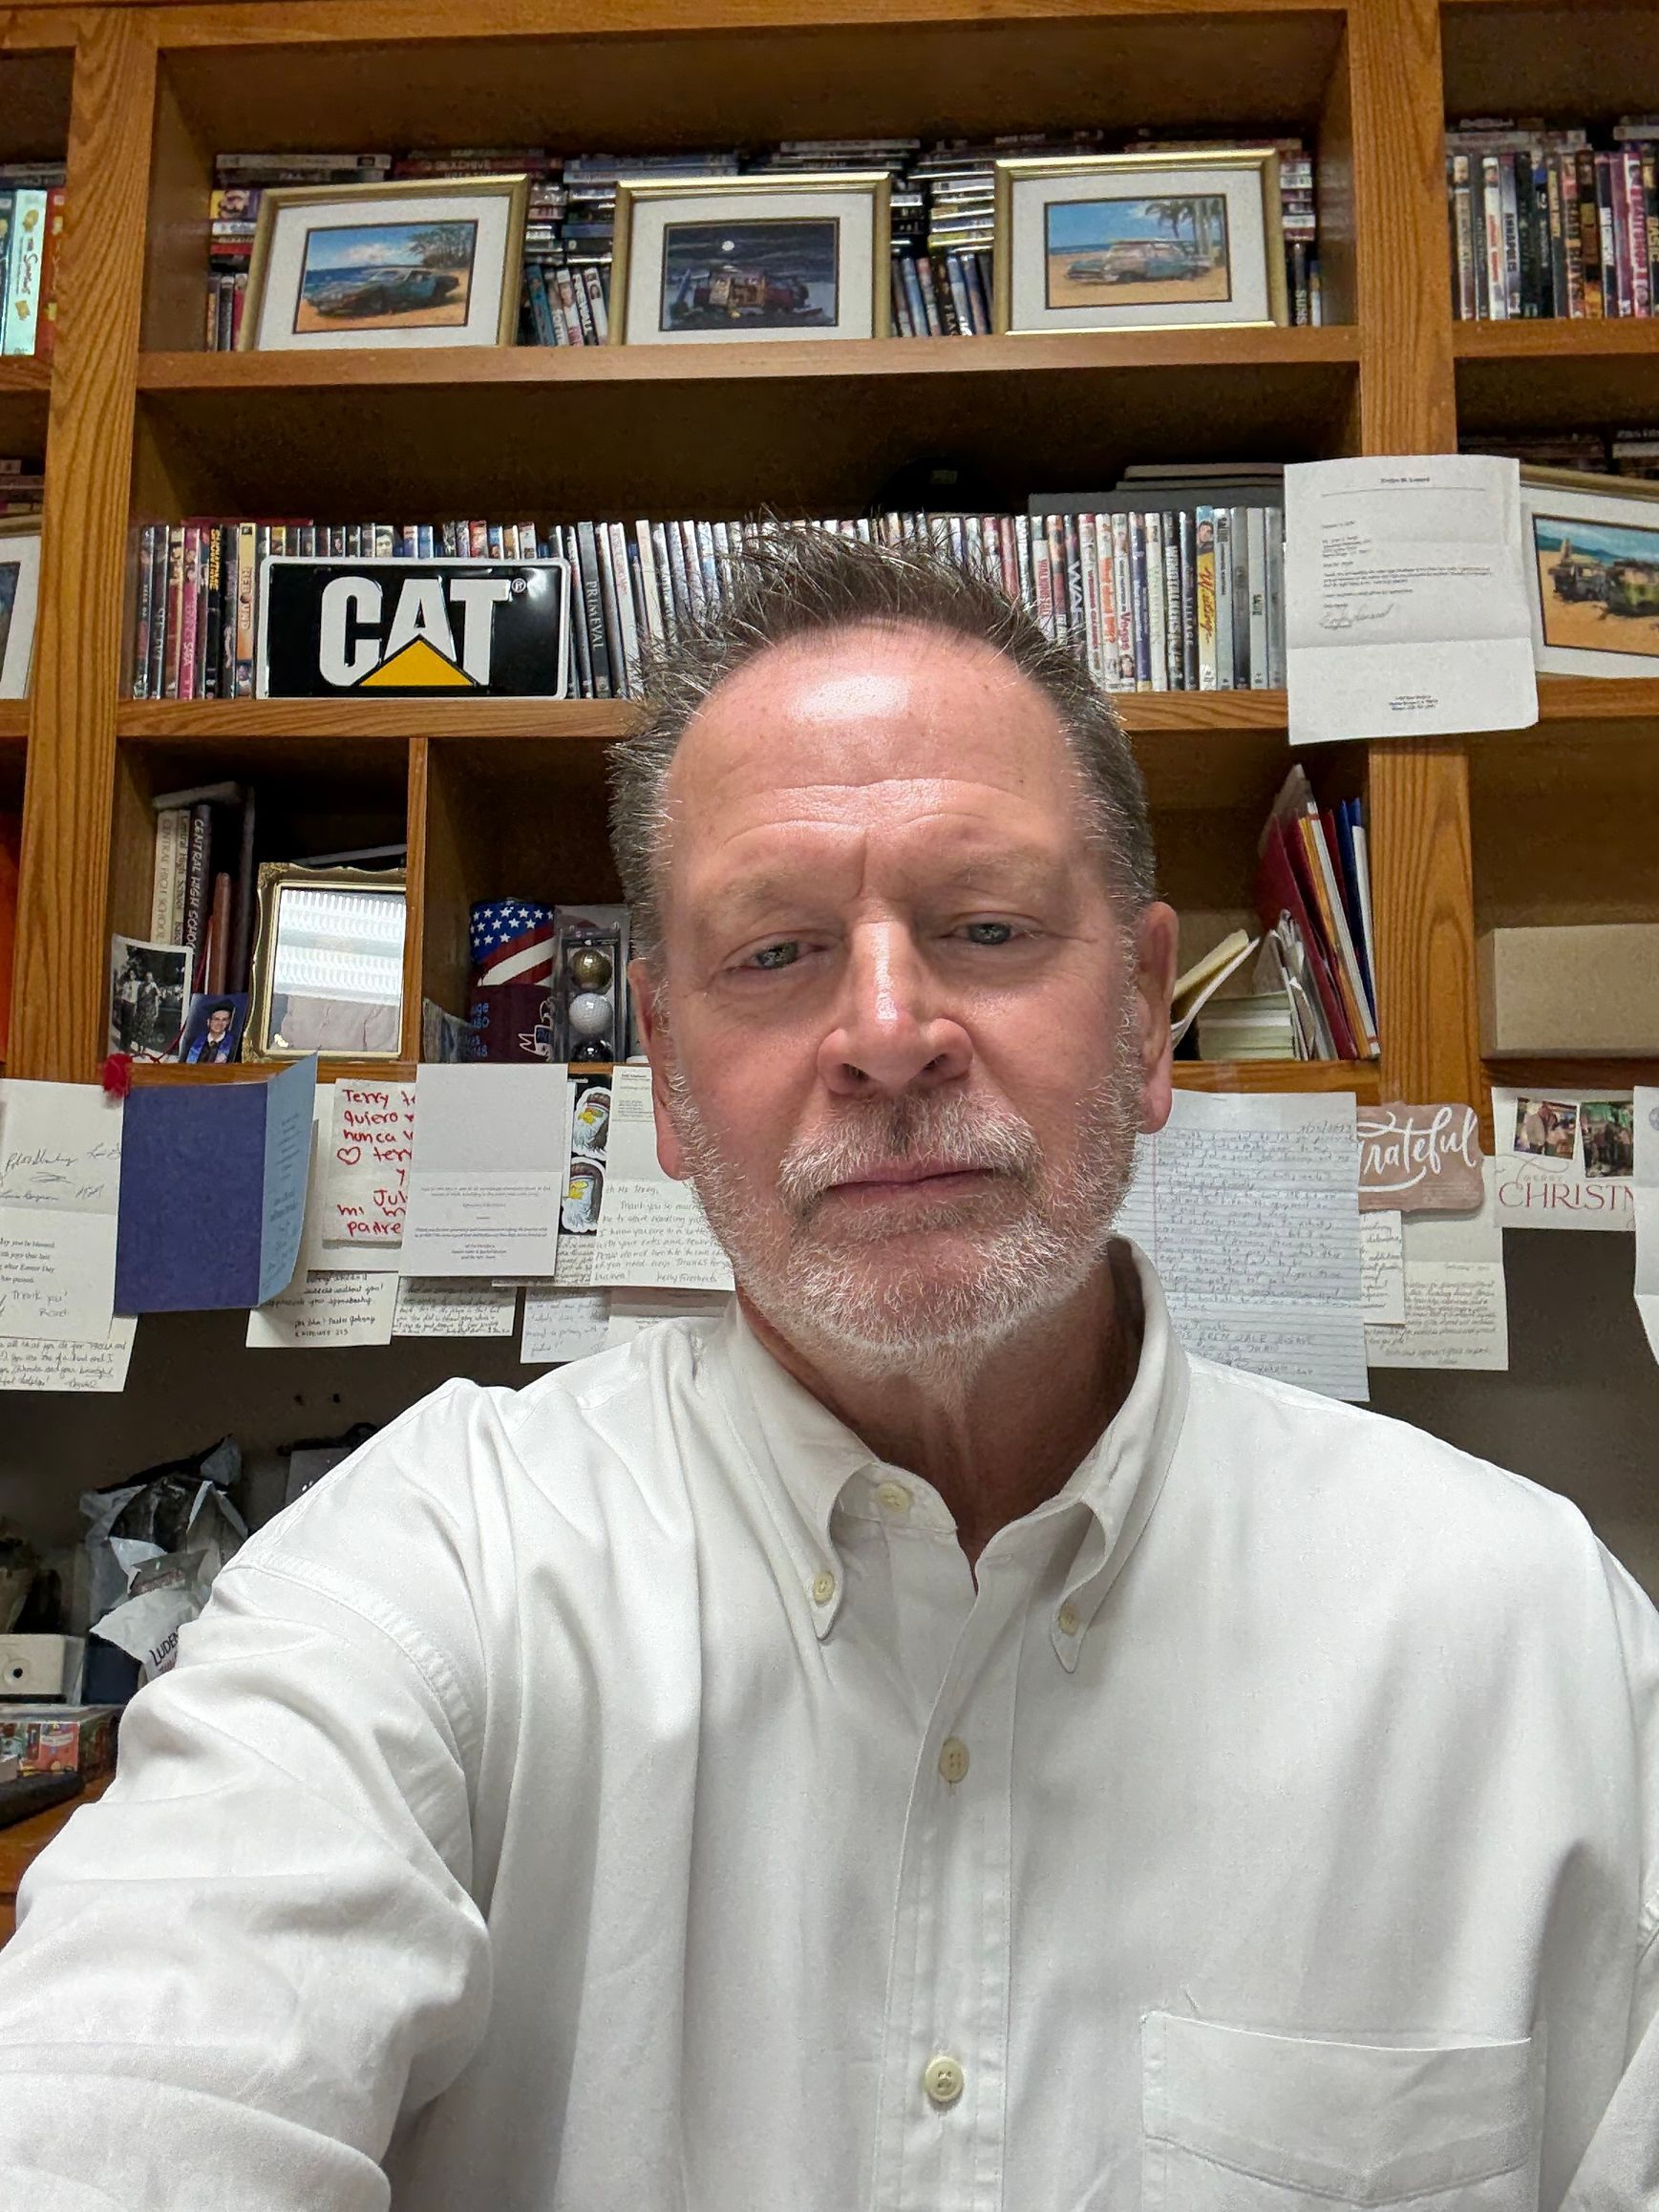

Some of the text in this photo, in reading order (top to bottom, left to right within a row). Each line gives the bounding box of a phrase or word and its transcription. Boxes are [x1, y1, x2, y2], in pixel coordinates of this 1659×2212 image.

[319, 575, 512, 687] CAT
[186, 819, 204, 952] CENTRAL HIGH SCHO
[342, 1090, 389, 1109] Terry
[343, 1129, 396, 1143] nunca
[1356, 1106, 1478, 1184] rateful
[373, 1146, 413, 1161] terr
[373, 1189, 408, 1206] Jul
